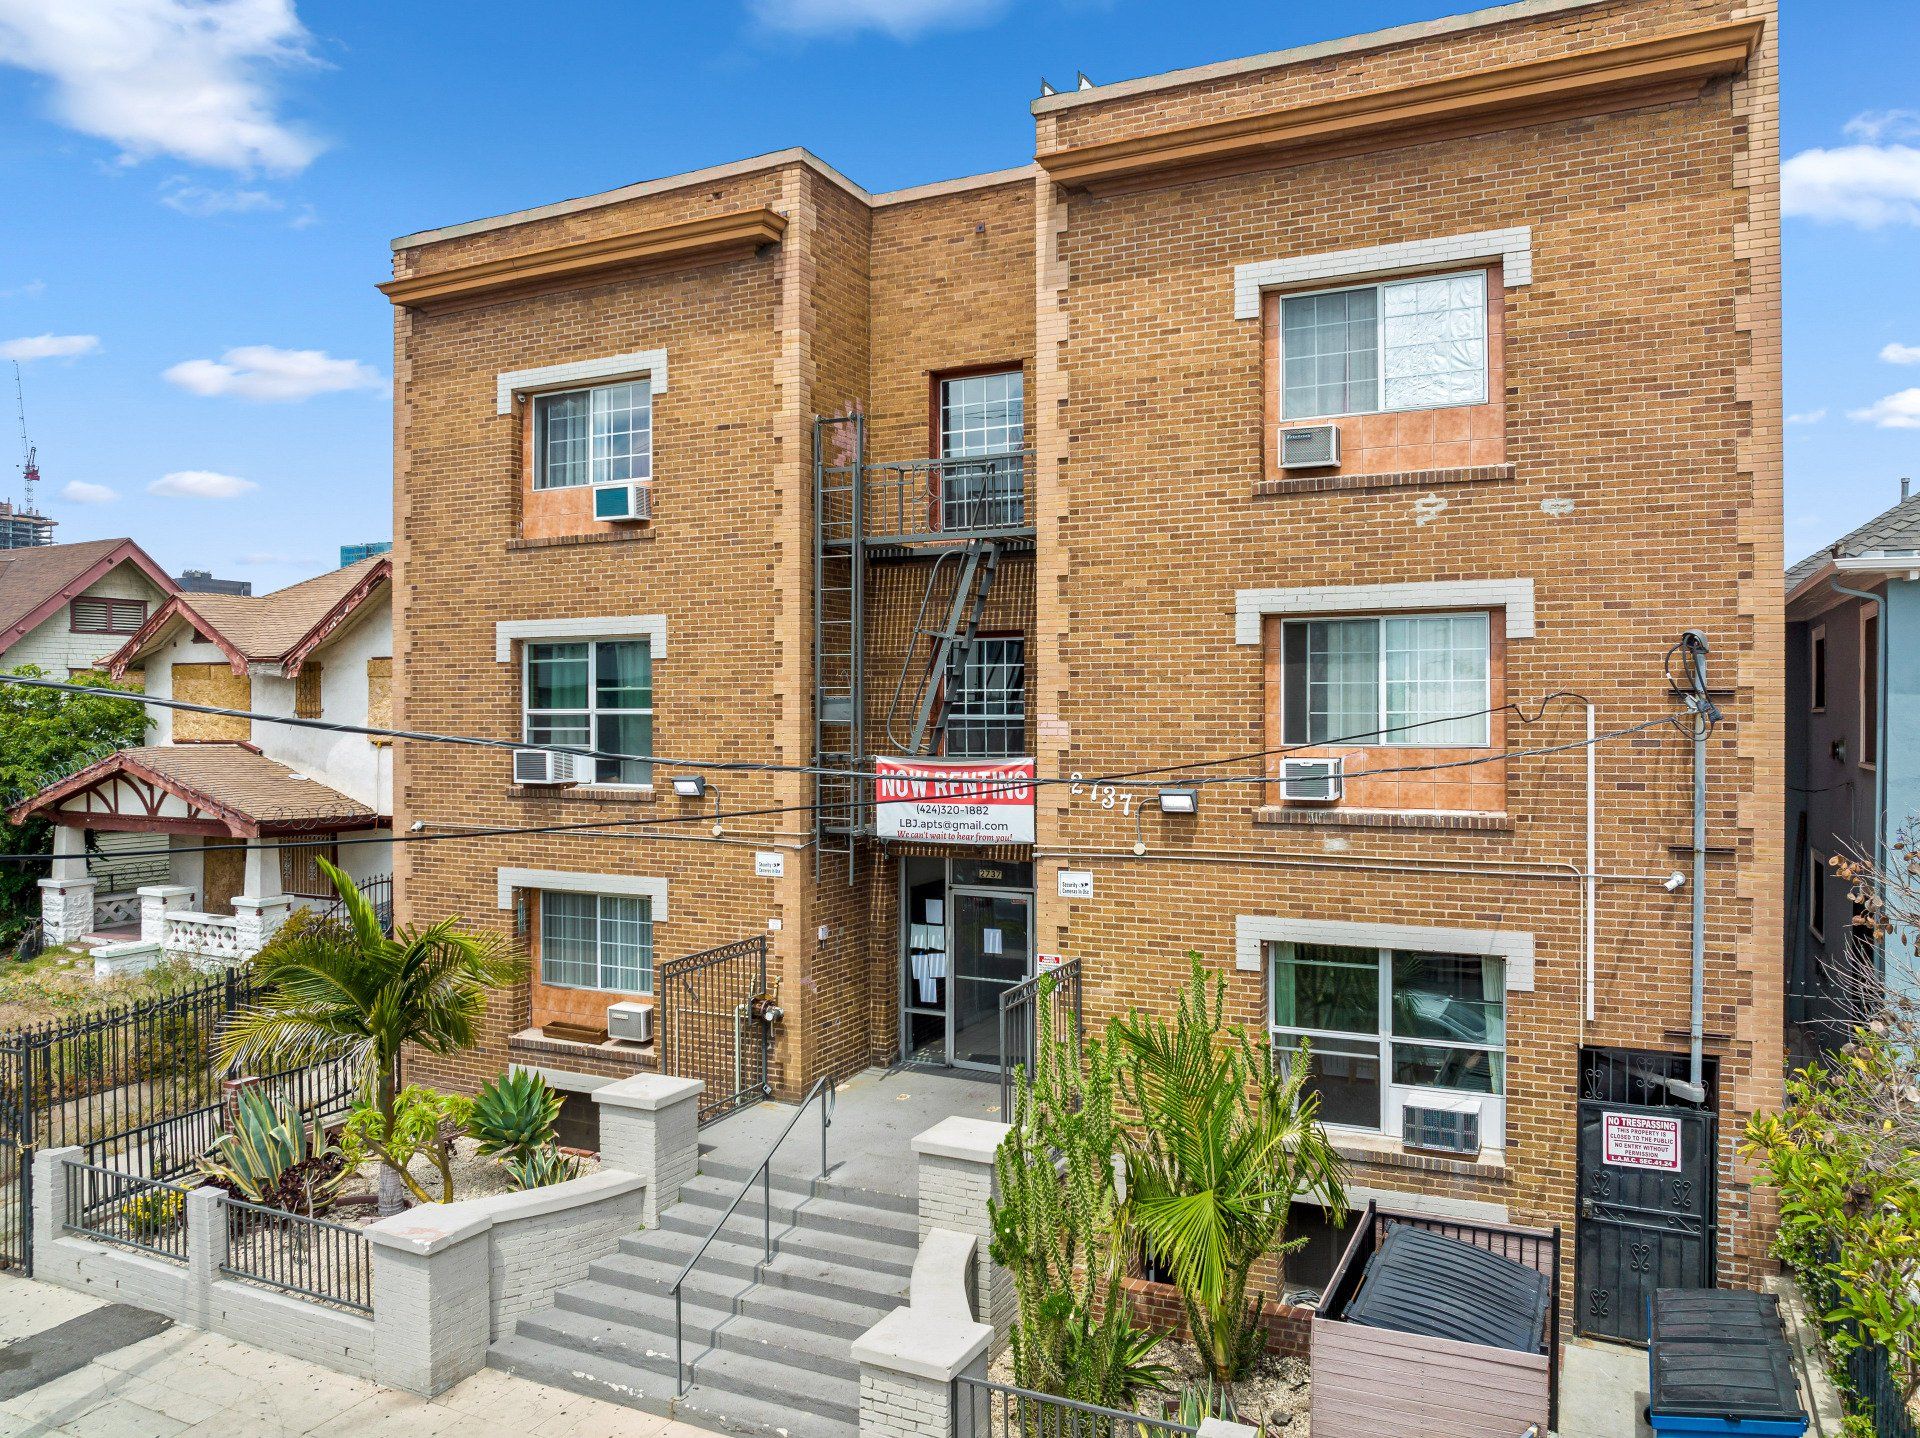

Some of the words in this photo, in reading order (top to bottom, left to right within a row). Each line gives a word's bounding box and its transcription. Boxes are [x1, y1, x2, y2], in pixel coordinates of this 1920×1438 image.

[881, 769, 929, 798] NOW
[934, 770, 1029, 800] RENTING
[916, 804, 990, 816] (424)320-1882
[899, 818, 1008, 831] LBJ.apts@gmail.com
[897, 830, 910, 838] We
[910, 831, 928, 839] can't
[947, 832, 956, 840] to
[956, 832, 974, 841] hear
[975, 832, 994, 842] from
[995, 833, 1013, 843] you!
[980, 870, 1001, 879] 2737
[1608, 1116, 1620, 1125] NO
[1621, 1118, 1676, 1131] TRESPASSING
[1630, 1128, 1660, 1137] PROPERTY
[1624, 1150, 1659, 1158] PERMISSION
[1643, 1145, 1669, 1153] WITHOUT
[1611, 1155, 1638, 1163] L.A.M.C.
